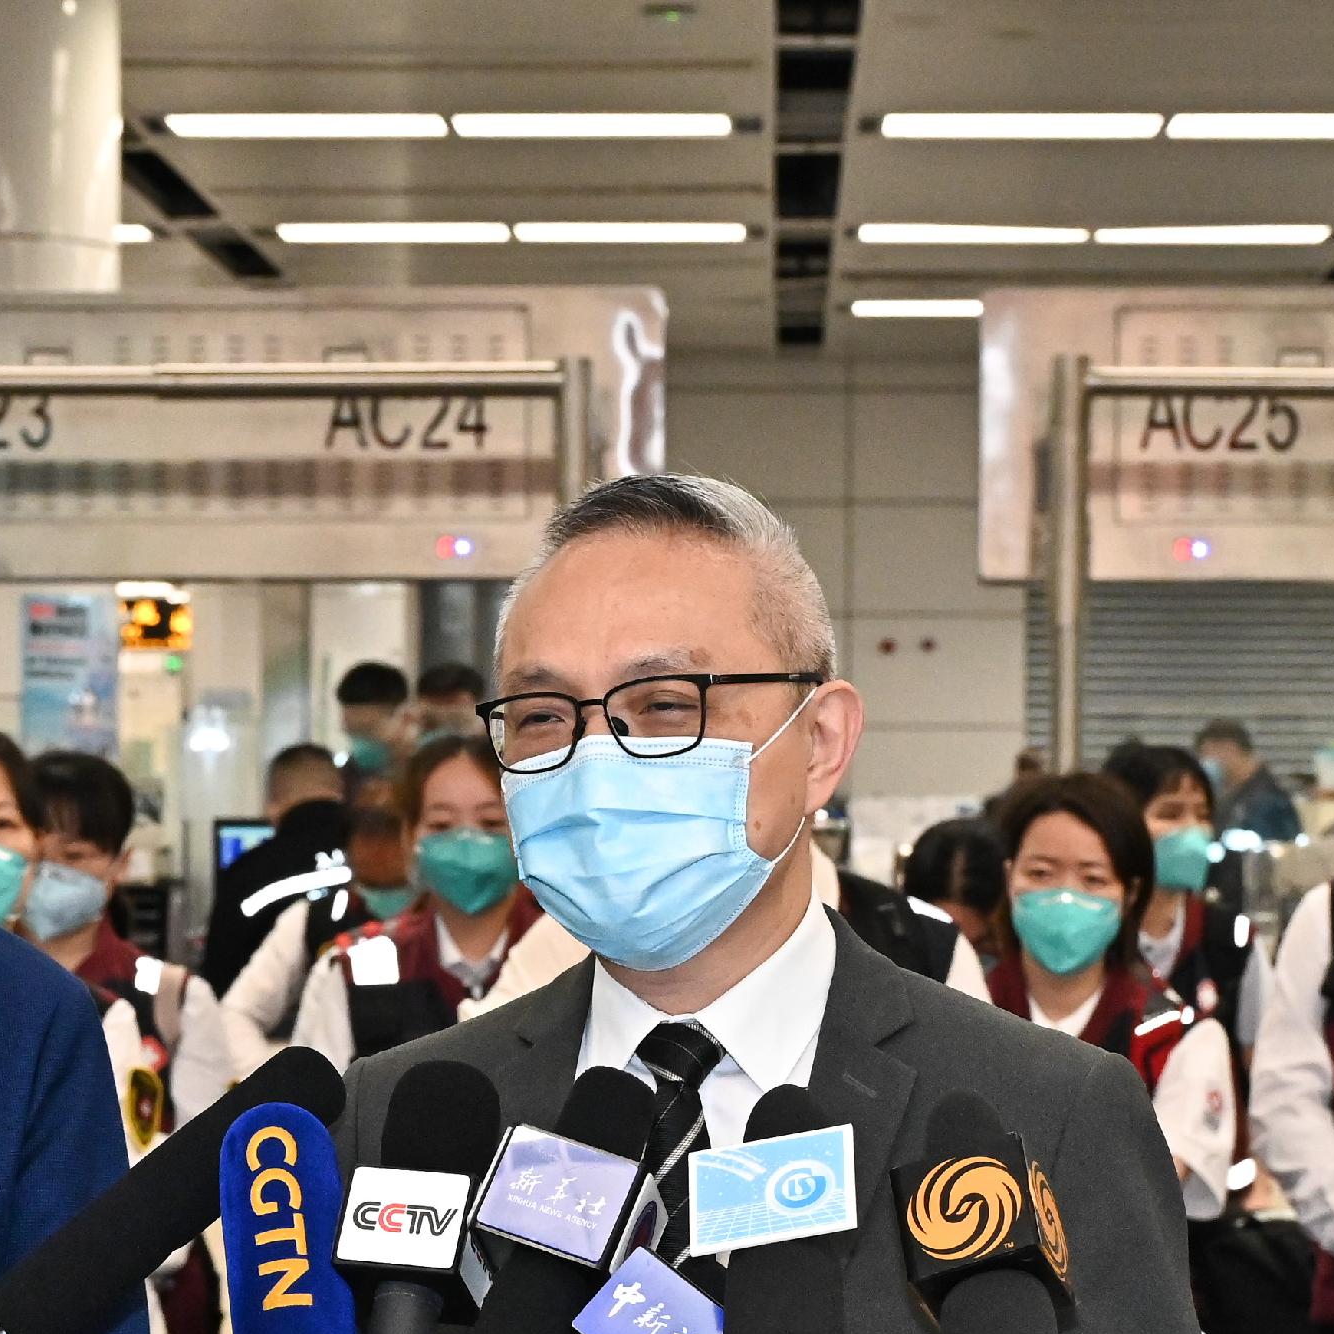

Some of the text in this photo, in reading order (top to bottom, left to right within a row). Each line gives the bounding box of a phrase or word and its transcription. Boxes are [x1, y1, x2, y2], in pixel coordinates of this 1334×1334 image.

[324, 394, 487, 449] AC24
[1139, 394, 1300, 452] AC25
[246, 1126, 313, 1311] CGTN
[352, 1201, 459, 1236] CCTV
[507, 1193, 597, 1230] XINHUA NEWS AGENCY
